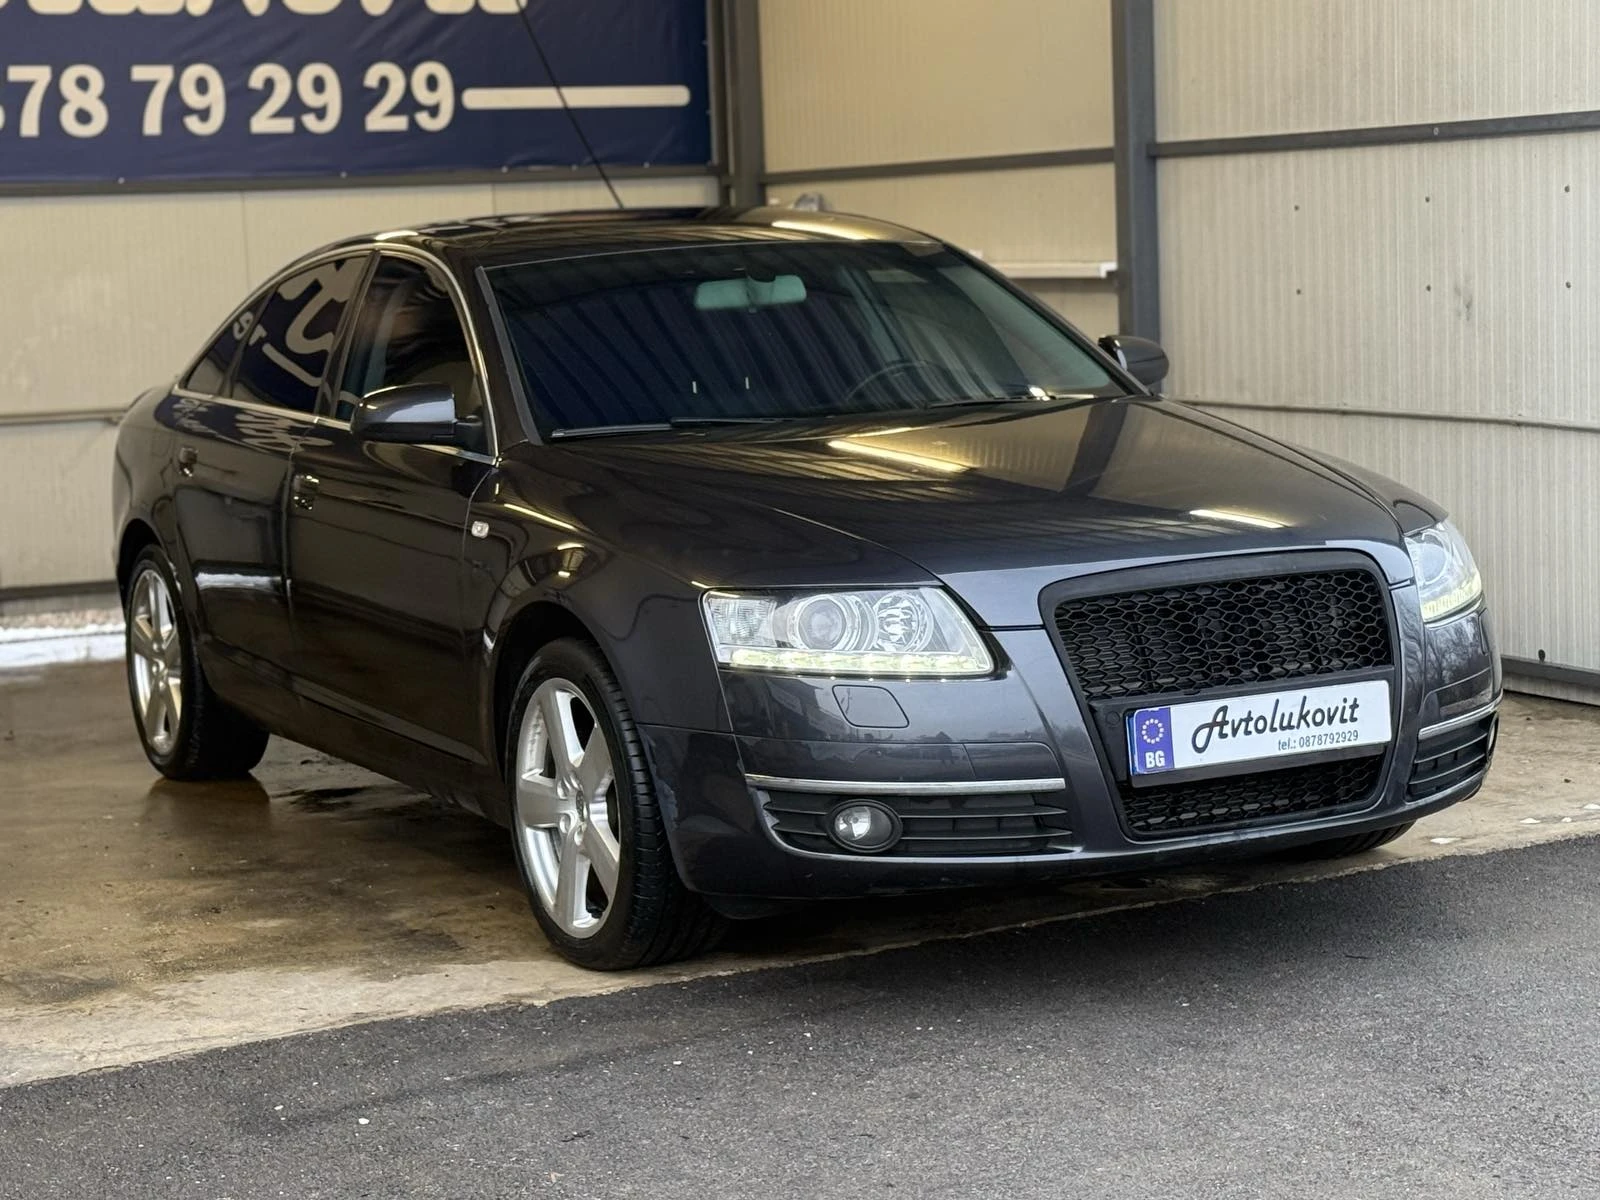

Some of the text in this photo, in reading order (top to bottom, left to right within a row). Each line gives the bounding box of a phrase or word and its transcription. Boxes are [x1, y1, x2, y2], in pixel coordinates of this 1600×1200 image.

[0, 60, 454, 138] 78 79 29 29
[1191, 695, 1360, 754] Avtolukovit
[1298, 729, 1359, 749] 0878792929
[1145, 750, 1166, 769] BG
